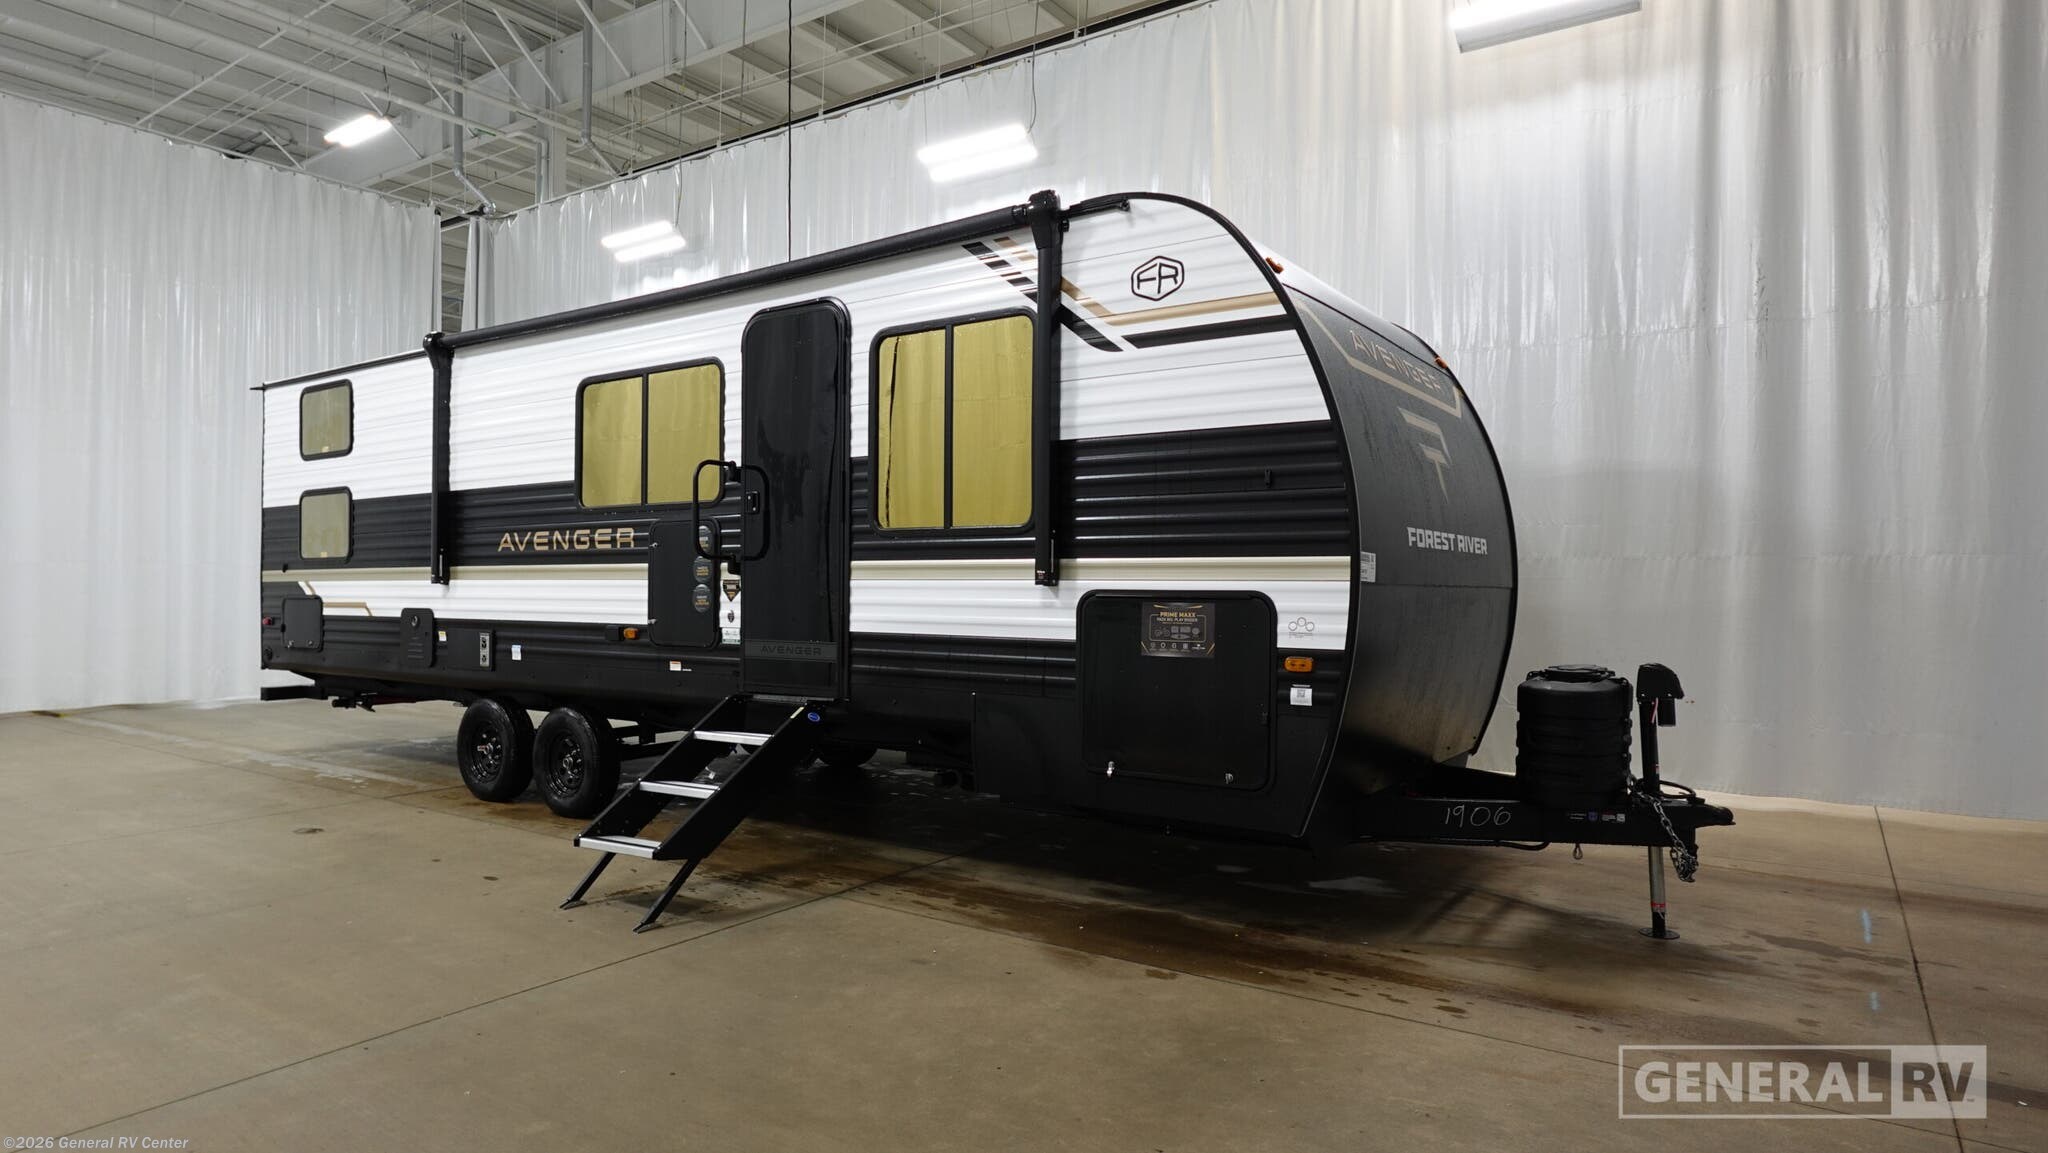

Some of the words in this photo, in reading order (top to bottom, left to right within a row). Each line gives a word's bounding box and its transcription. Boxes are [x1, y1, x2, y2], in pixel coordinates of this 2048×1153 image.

[1137, 262, 1179, 294] FR
[498, 527, 635, 552] AVENGER
[1406, 526, 1456, 551] FOREST
[1456, 534, 1488, 555] RIVER
[760, 645, 822, 656] AVENGER
[1445, 804, 1511, 828] 1906
